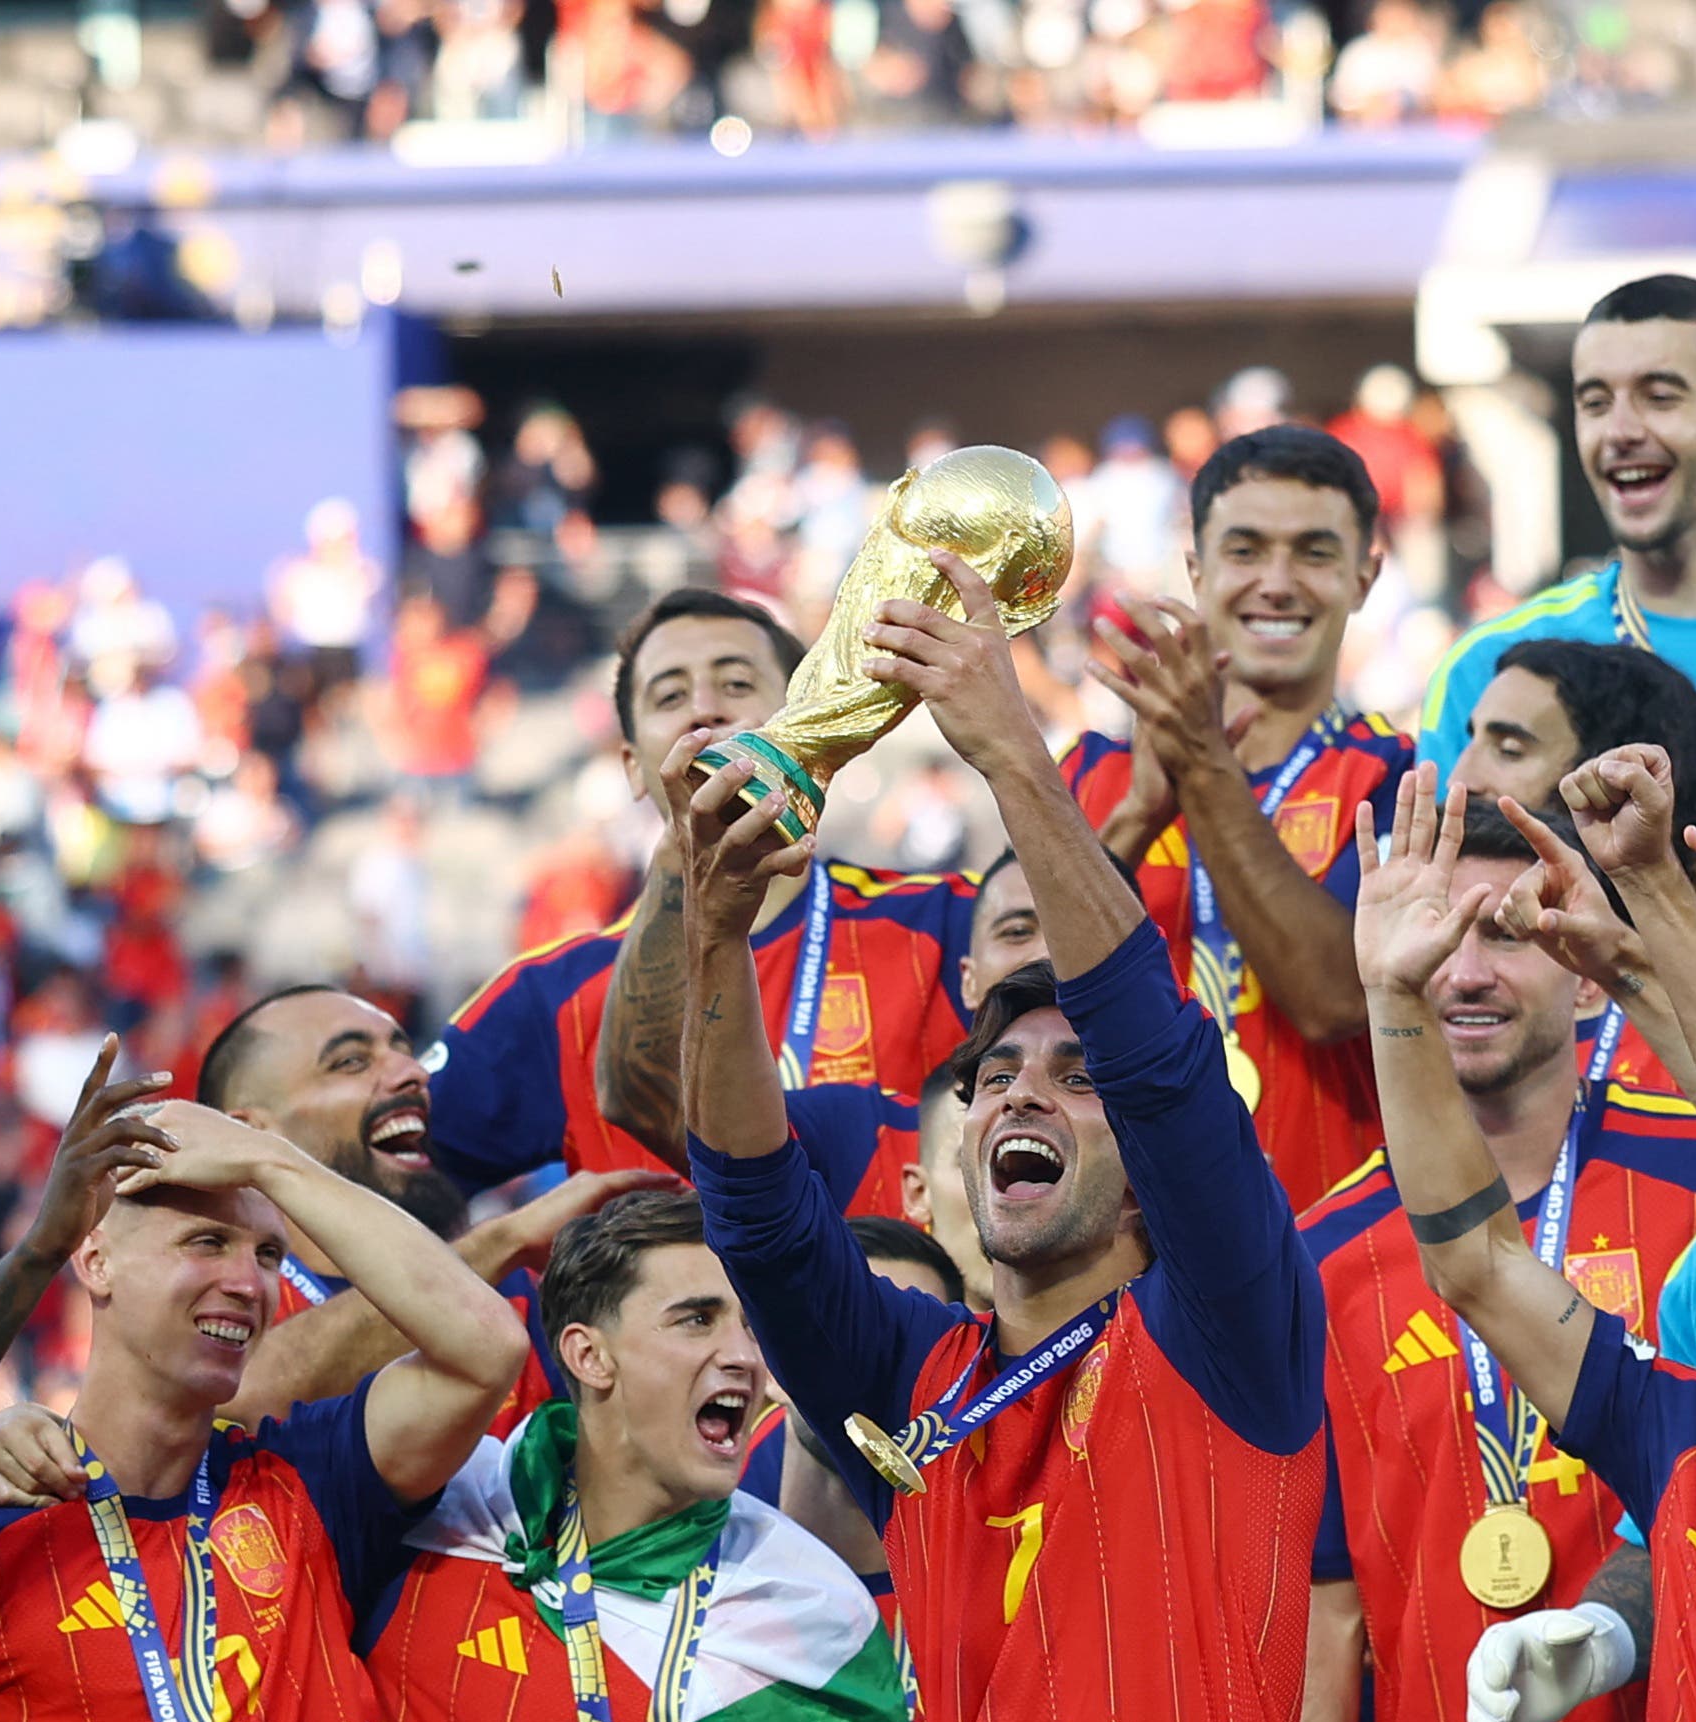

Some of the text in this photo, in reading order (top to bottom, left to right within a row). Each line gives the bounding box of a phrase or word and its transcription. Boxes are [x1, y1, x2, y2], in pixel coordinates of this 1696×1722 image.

[809, 910, 827, 942] CUP
[799, 943, 823, 999] WORLD
[793, 1000, 814, 1035] FIFA
[1599, 1013, 1622, 1049] CUP
[1546, 1183, 1564, 1220] CUP
[292, 1272, 326, 1306] ORLD
[962, 1402, 995, 1423] FIFA
[986, 1369, 1034, 1403] WORLD
[1029, 1351, 1055, 1373] CUP
[1052, 1322, 1093, 1358] 2026
[1470, 1342, 1495, 1406] 2026
[197, 1476, 211, 1504] FIFA
[985, 1502, 1044, 1625] 7
[143, 1650, 166, 1690] FIFA
